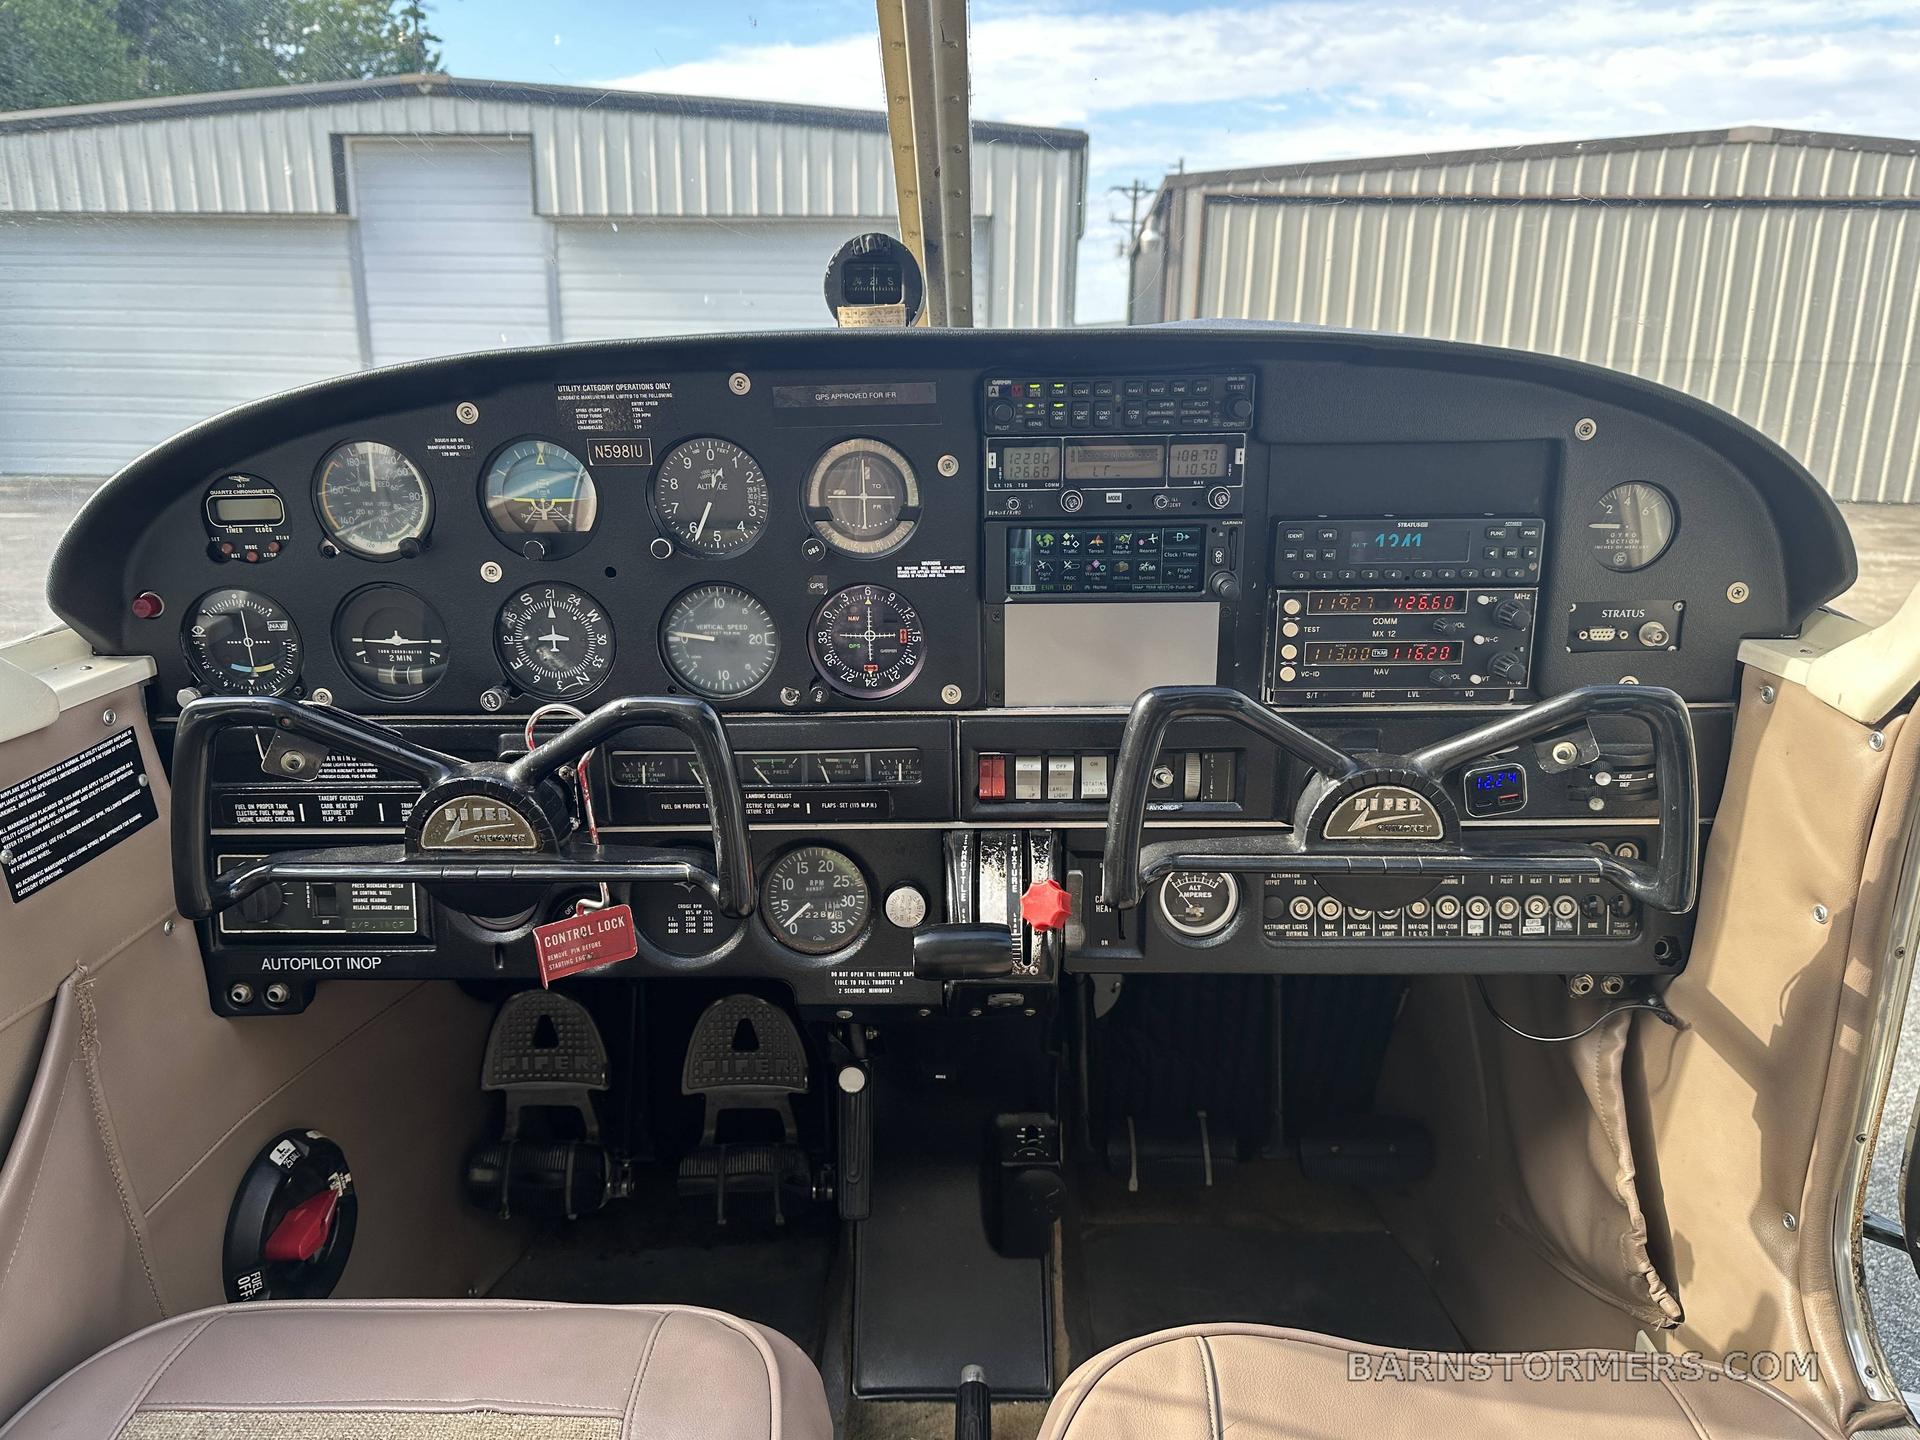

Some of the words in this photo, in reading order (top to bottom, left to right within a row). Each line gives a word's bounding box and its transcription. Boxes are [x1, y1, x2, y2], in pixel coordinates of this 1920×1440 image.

[616, 383, 654, 391] OPERATIONS
[706, 449, 715, 460] 0
[683, 457, 692, 469] 9
[732, 457, 738, 468] 1
[746, 471, 754, 483] 2
[670, 478, 678, 490] 8
[671, 502, 679, 514] 7
[748, 505, 756, 516] 3
[1606, 505, 1613, 514] 2
[689, 522, 698, 533] 6
[737, 521, 745, 532] 4
[713, 530, 722, 542] 5
[546, 589, 555, 598] 21
[864, 587, 871, 595] 6
[520, 593, 533, 605] S
[568, 594, 581, 606] 24
[840, 593, 849, 602] 3
[888, 593, 896, 601] 9
[714, 598, 725, 608] 10
[587, 609, 601, 623] W
[823, 610, 832, 619] 0
[904, 606, 915, 618] 12
[1602, 609, 1645, 618] STRATUS
[504, 635, 514, 645] 12
[597, 634, 607, 645] 30
[748, 634, 763, 645] 20
[818, 632, 828, 644] 33
[912, 631, 921, 642] 15
[510, 657, 524, 670] E
[592, 655, 604, 668] 33
[823, 654, 836, 667] 30
[905, 654, 917, 666] 18
[533, 675, 540, 683] 6
[576, 672, 590, 686] N
[718, 670, 729, 680] 10
[840, 672, 855, 682] 27
[888, 671, 900, 682] 21
[557, 681, 563, 689] 3
[864, 678, 878, 687] 24
[445, 803, 511, 820] PIPER
[797, 862, 808, 874] 15
[818, 861, 834, 872] 20
[960, 845, 970, 902] THROTTLE
[782, 879, 794, 890] 10
[833, 876, 849, 887] 25
[781, 900, 789, 911] 5
[840, 895, 856, 907] 30
[544, 926, 594, 948] CONTROL
[598, 916, 625, 932] LOCK
[790, 923, 797, 934] 0
[830, 922, 845, 934] 35
[547, 951, 568, 961] REMOVE
[582, 941, 602, 952] BEFORE
[261, 958, 342, 970] AUTOPILOT
[347, 957, 382, 970] INOP
[548, 958, 574, 970] STARTING
[250, 1271, 263, 1294] FUEL
[238, 1276, 253, 1302] OFF
